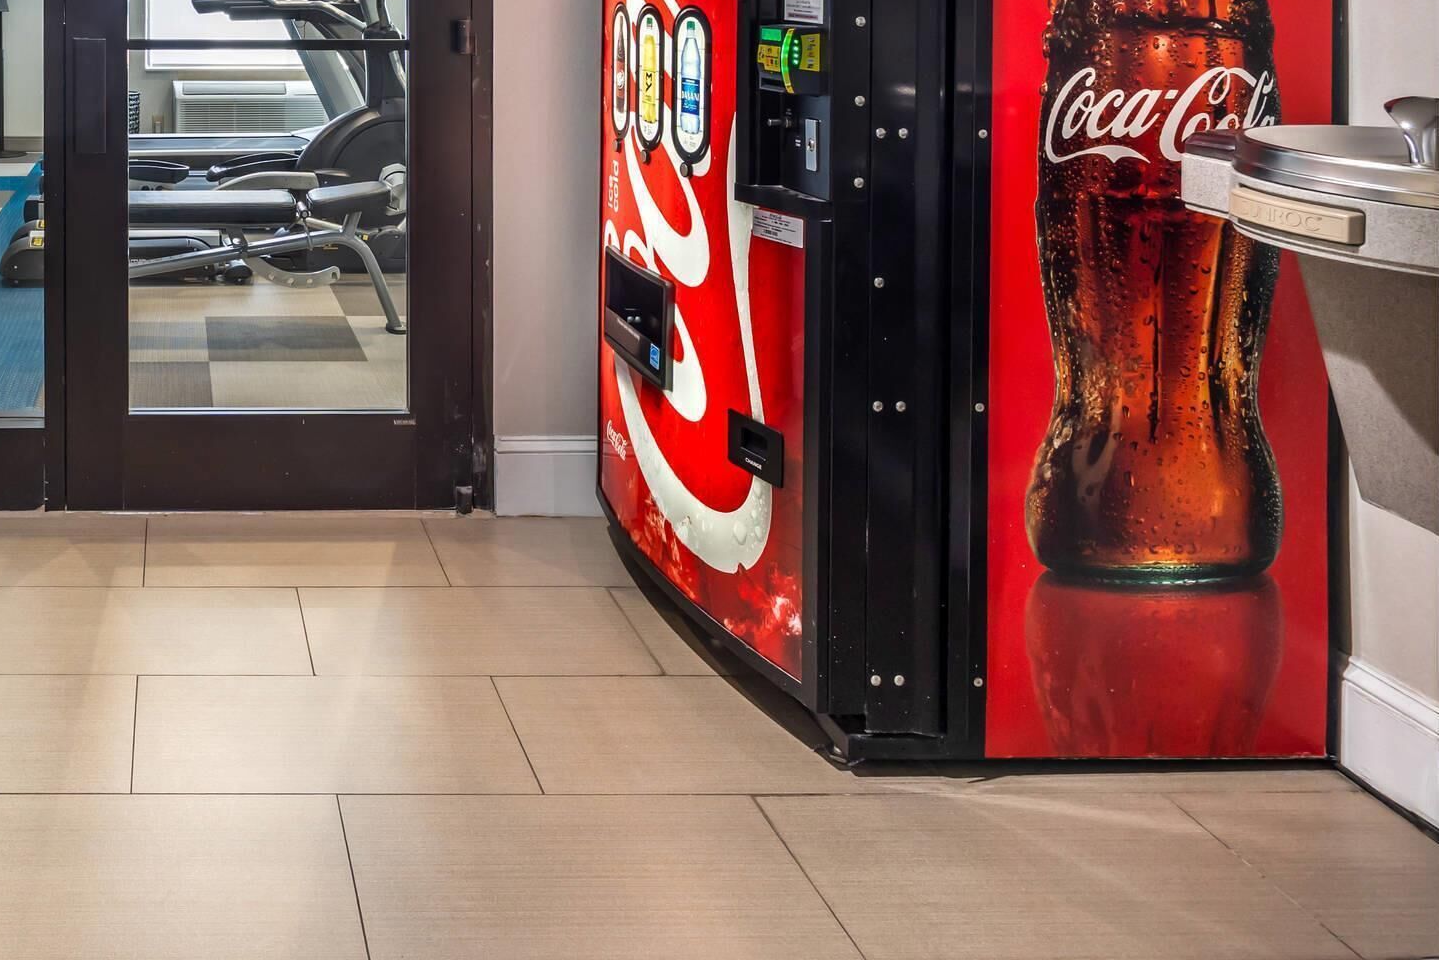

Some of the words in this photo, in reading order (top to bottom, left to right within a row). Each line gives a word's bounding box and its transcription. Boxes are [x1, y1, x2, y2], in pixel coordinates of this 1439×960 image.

[1045, 66, 1275, 163] Coca-Col
[607, 419, 627, 461] Coca-Cola
[745, 457, 762, 470] CHANGE
